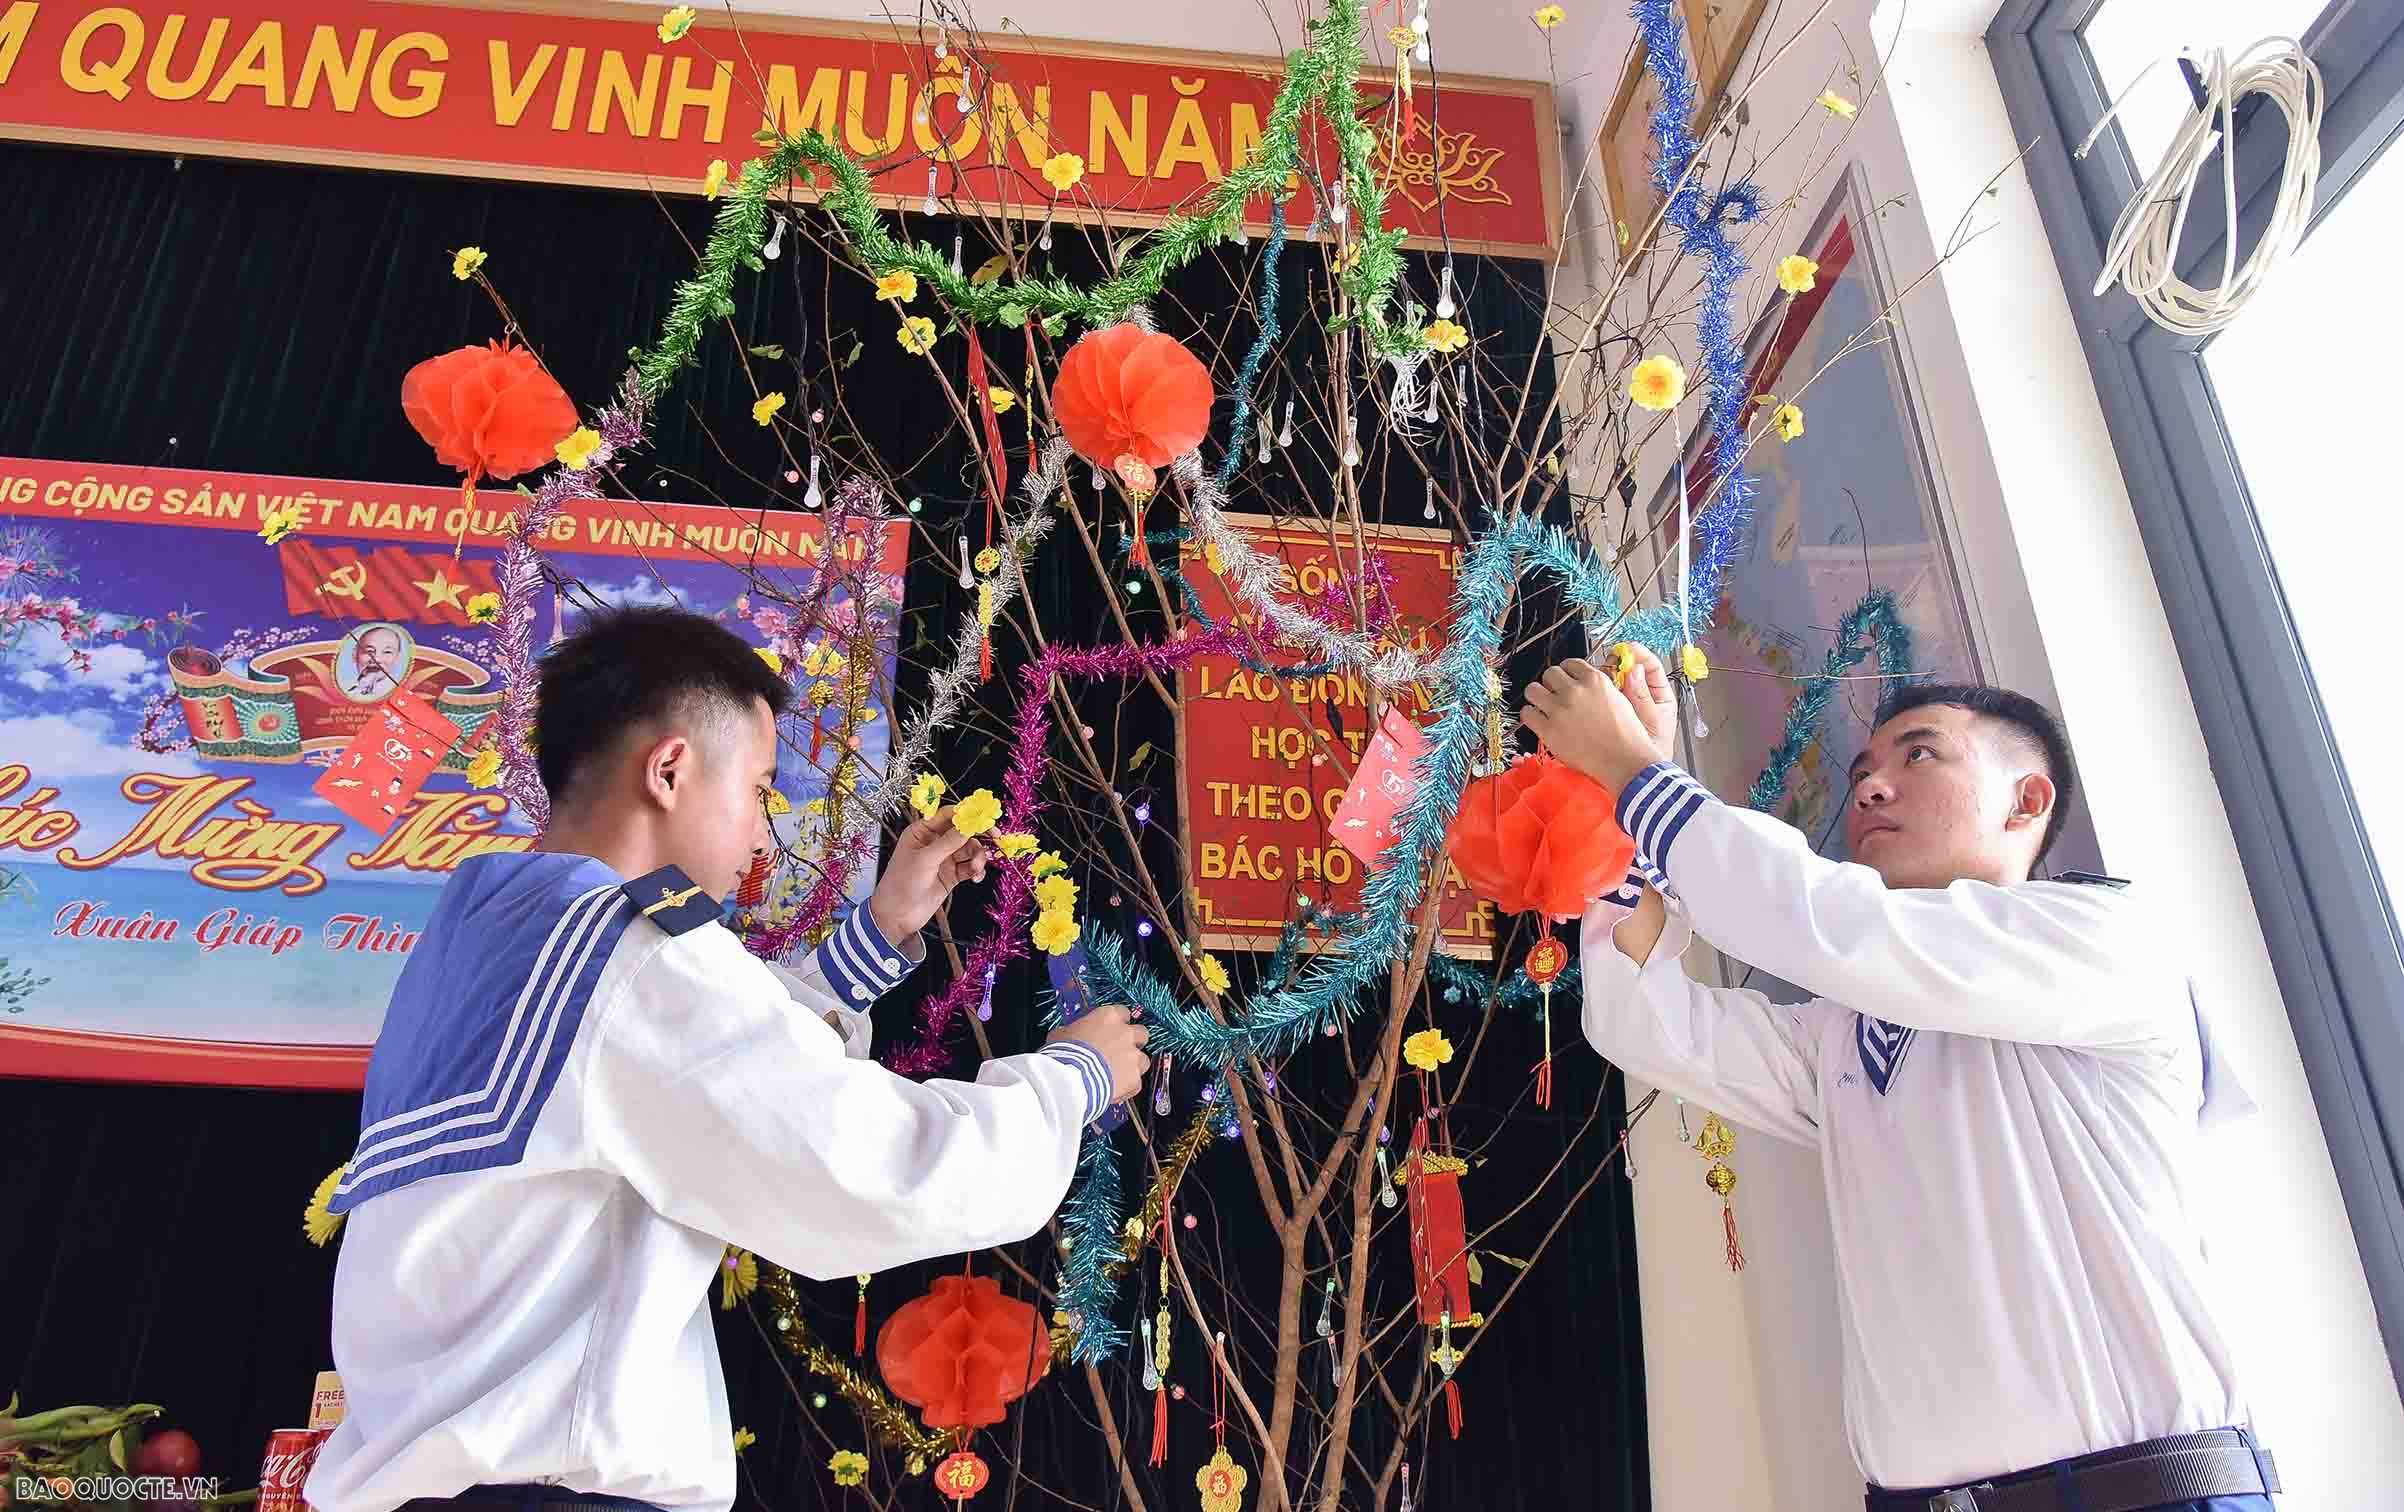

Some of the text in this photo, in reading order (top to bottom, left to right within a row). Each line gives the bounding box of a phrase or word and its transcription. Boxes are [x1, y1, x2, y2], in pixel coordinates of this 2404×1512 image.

[59, 5, 450, 119] QUANG
[487, 38, 734, 145] VINH
[759, 55, 1053, 170] MUÔN
[43, 475, 155, 517] CỘNG
[159, 481, 248, 520] SẢN
[347, 501, 440, 533] NAM
[586, 516, 679, 550] VINH
[682, 522, 791, 557] MUÔN
[1200, 665, 1280, 703] LAO
[1206, 781, 1313, 822] THEO
[56, 772, 344, 896] Mừng
[1200, 835, 1284, 882] BÁC
[53, 899, 180, 943] Xuân
[192, 907, 304, 956] Giáp
[316, 1389, 345, 1401] FREE
[946, 1459, 976, 1489] 福
